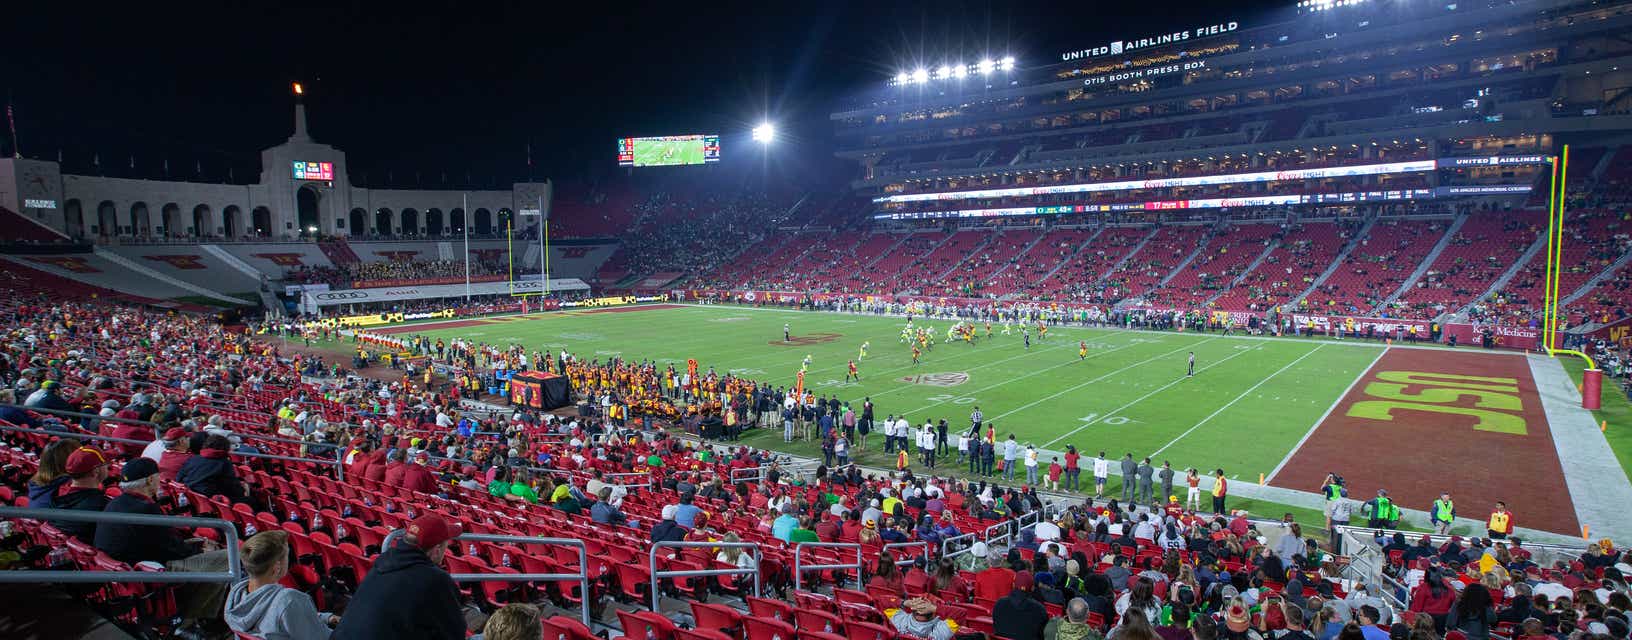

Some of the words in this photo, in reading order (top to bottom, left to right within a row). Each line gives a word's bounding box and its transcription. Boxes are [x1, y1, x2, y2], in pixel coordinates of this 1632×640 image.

[1062, 46, 1108, 61] UNITED
[1125, 31, 1190, 50] AIRLINES
[1196, 21, 1238, 37] FIELD
[1084, 75, 1106, 86] OTIS
[1109, 70, 1142, 82] BOOTH
[1146, 64, 1180, 75] PRESS
[1184, 60, 1206, 70] BOX
[1472, 335, 1483, 344] of
[1496, 326, 1537, 338] Medicine
[1345, 371, 1528, 435] USC
[1077, 413, 1130, 425] 10
